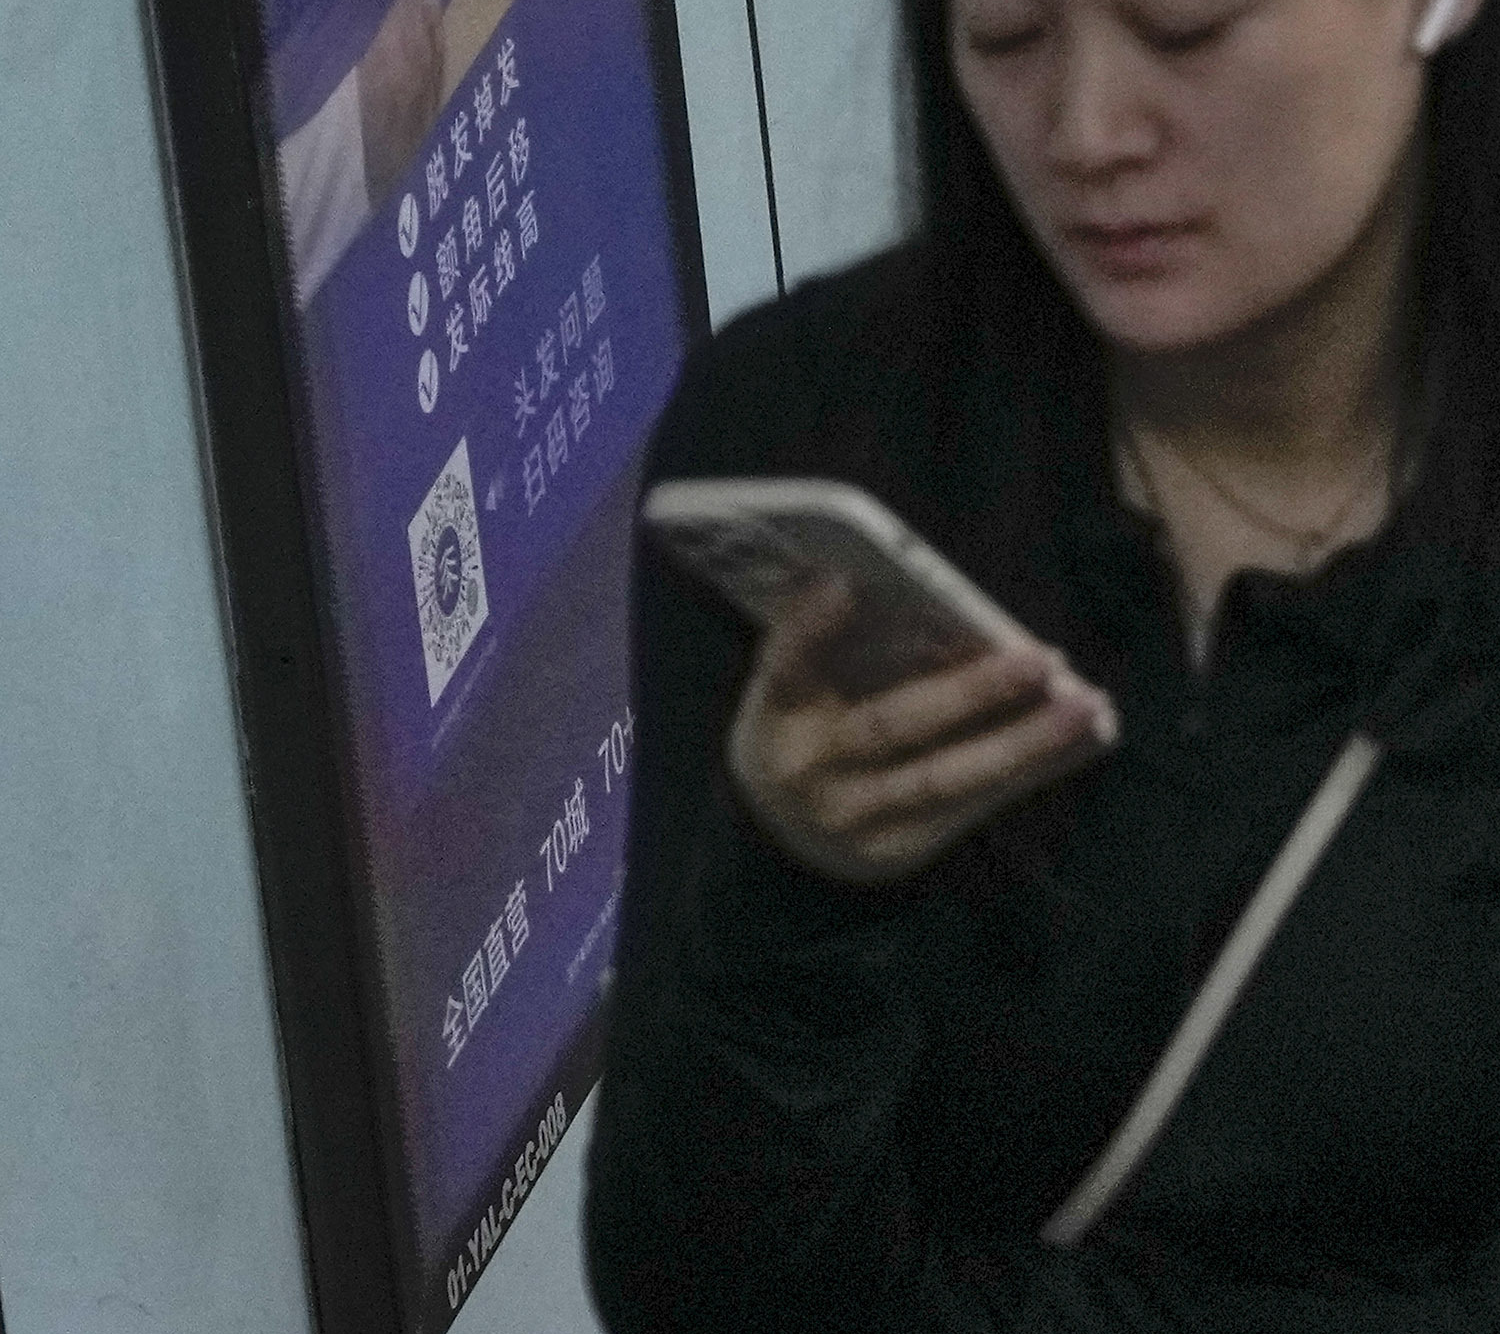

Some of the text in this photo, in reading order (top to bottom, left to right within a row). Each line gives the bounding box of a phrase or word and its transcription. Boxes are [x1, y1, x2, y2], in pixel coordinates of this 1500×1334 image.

[425, 38, 519, 219] 脱发掉发
[435, 117, 532, 301] 额角后移
[445, 188, 540, 372] 发际线高
[513, 254, 608, 438] 头发问题
[522, 338, 616, 516] 扫码咨询
[440, 879, 530, 1068] 全国直营
[538, 777, 591, 893] 70城
